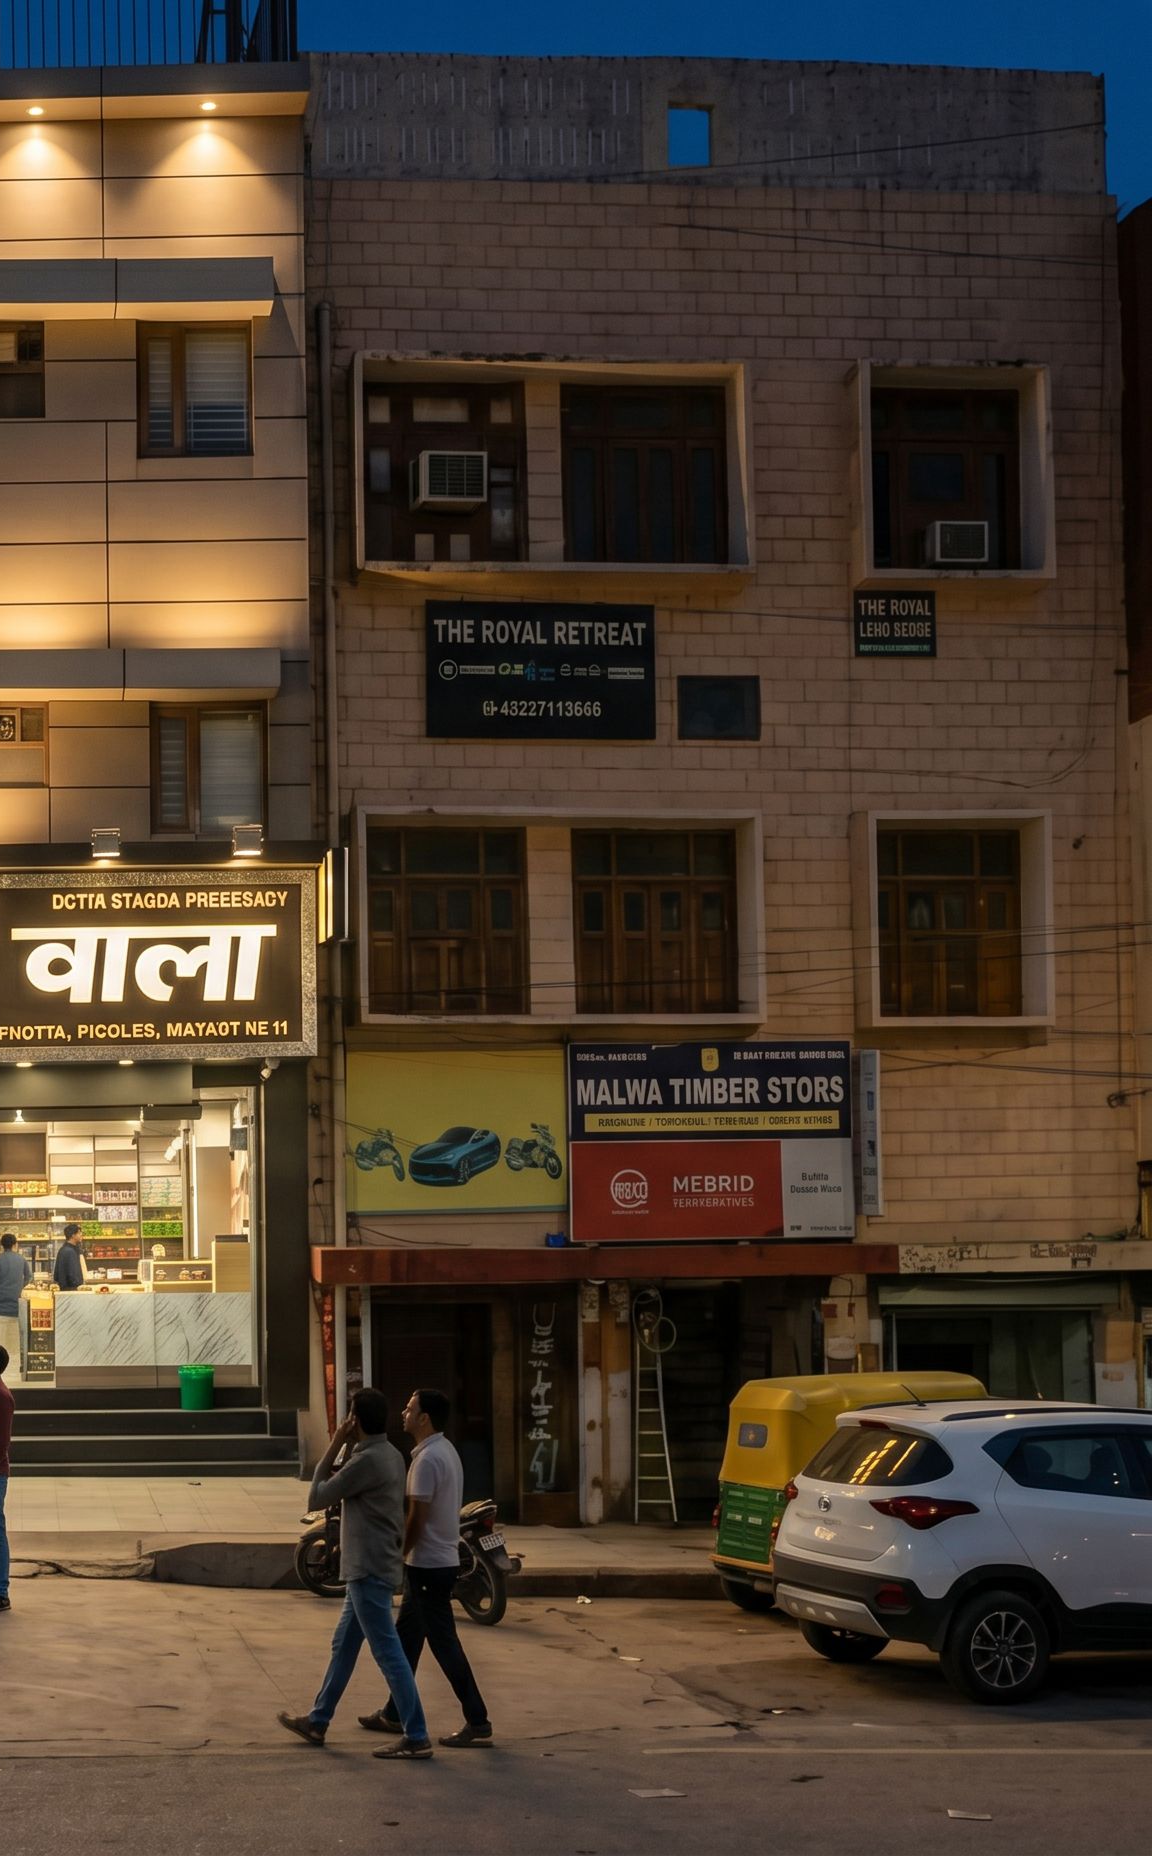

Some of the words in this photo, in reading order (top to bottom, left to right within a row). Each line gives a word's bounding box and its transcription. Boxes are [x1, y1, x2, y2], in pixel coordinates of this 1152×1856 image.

[858, 599, 887, 616] THE
[890, 599, 932, 616] ROYAL
[433, 619, 475, 643] THE
[481, 620, 548, 645] ROYAL
[554, 621, 647, 646] RETREAT
[111, 892, 180, 909] STAGDA
[11, 924, 278, 1004] वाला
[77, 1023, 161, 1040] PICOLES,
[245, 1021, 269, 1036] NE
[272, 1020, 288, 1035] 11
[576, 1079, 663, 1105] MALWA
[669, 1077, 760, 1105] TIMBER
[767, 1075, 845, 1104] STORS
[673, 1175, 755, 1193] MEBRID
